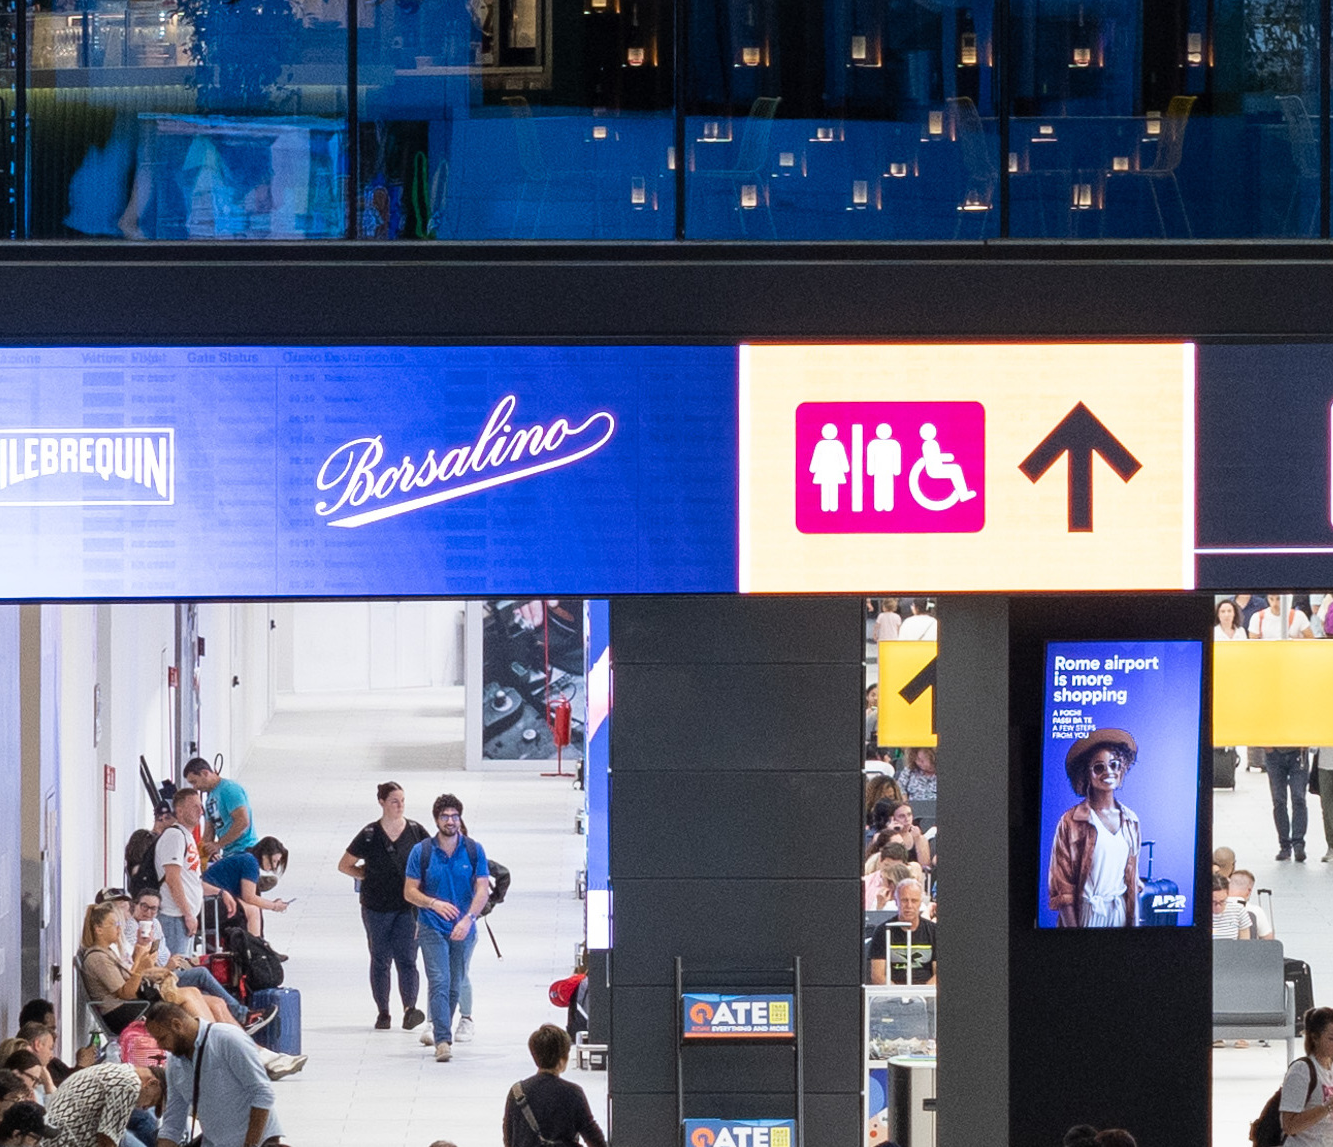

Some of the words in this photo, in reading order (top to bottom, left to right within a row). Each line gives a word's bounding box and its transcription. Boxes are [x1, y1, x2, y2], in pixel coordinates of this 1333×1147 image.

[316, 394, 616, 520] Borsalino
[1054, 655, 1101, 671] Rome
[1104, 654, 1160, 674] airport
[1054, 670, 1068, 687] is
[1071, 673, 1114, 687] more
[1053, 686, 1128, 706] shopping
